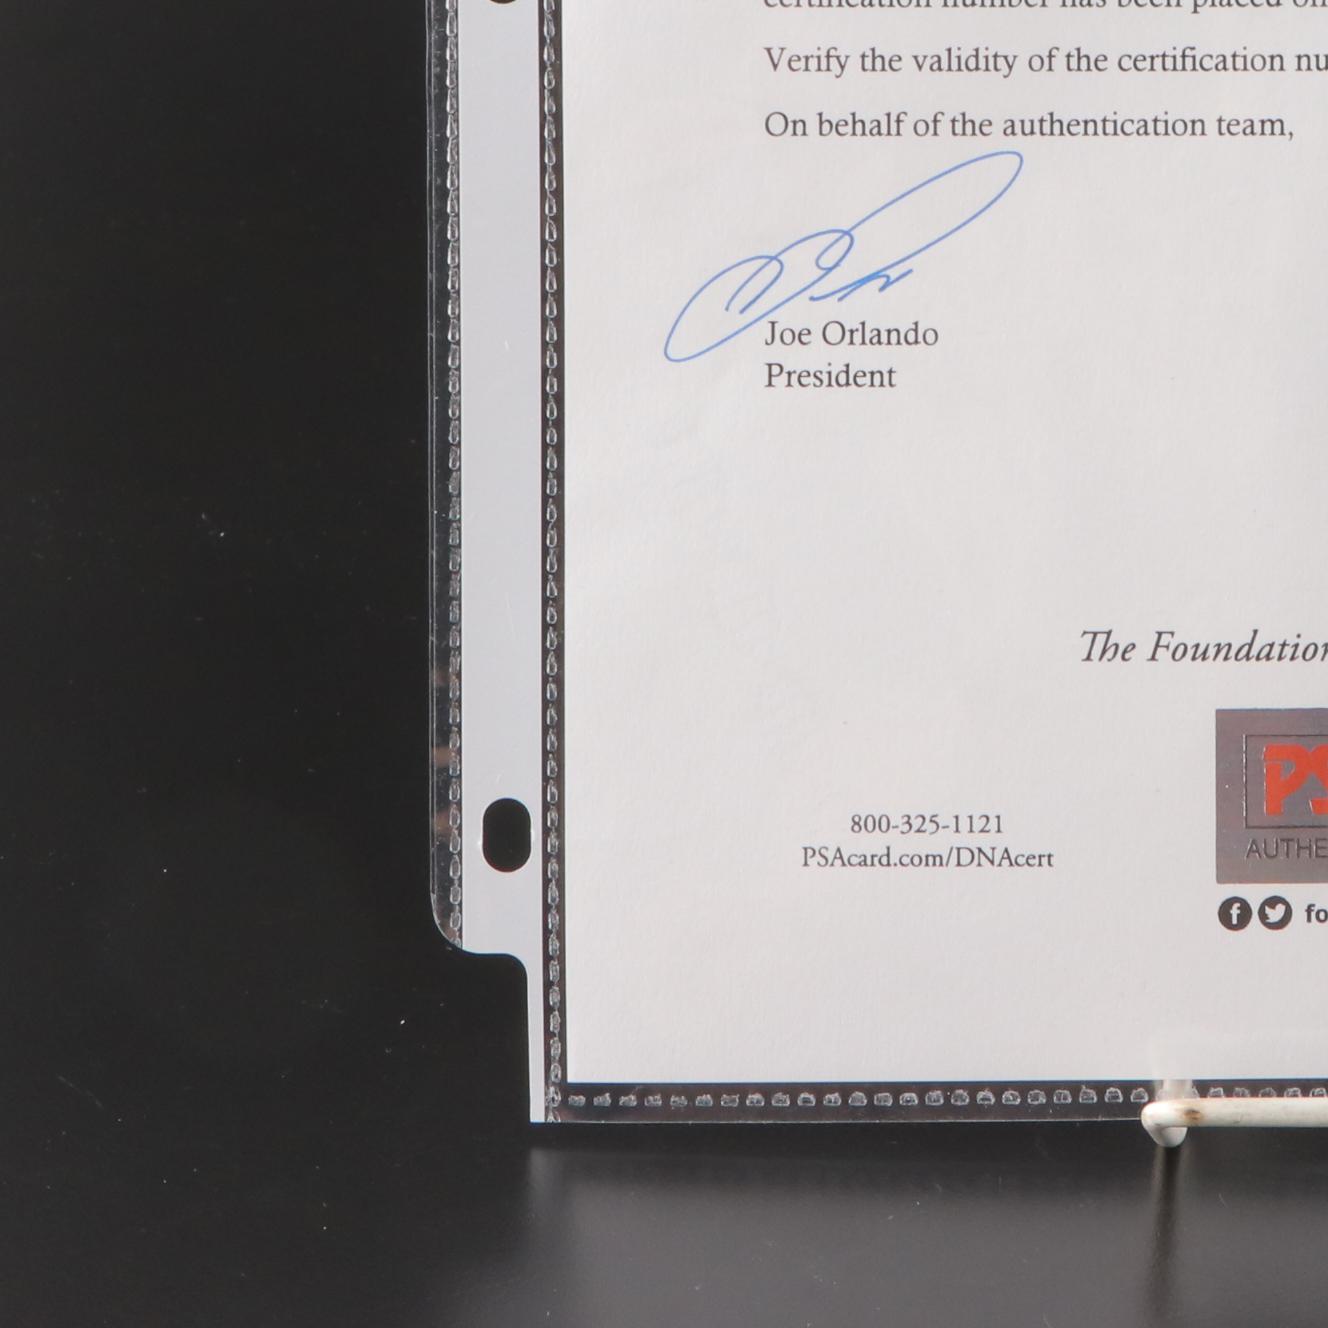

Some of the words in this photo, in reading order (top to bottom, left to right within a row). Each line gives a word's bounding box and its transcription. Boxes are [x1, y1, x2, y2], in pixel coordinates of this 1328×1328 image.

[763, 46, 851, 79] Verify
[859, 46, 903, 73] the
[911, 46, 1019, 79] validity
[1027, 46, 1061, 73] of
[1064, 46, 1109, 73] the
[1116, 45, 1287, 73] certification
[764, 111, 809, 138] On
[815, 110, 909, 138] behalf
[912, 110, 946, 138] of
[949, 111, 993, 137] the
[1002, 110, 1208, 138] authentication
[1215, 115, 1294, 142] team,
[764, 320, 813, 347] Joe
[821, 319, 940, 347] Orlando
[764, 361, 897, 389] President
[1080, 628, 1137, 663] The
[850, 813, 1004, 836] 800-325-1121
[801, 845, 1055, 868] PSAcard.com/DNAcert
